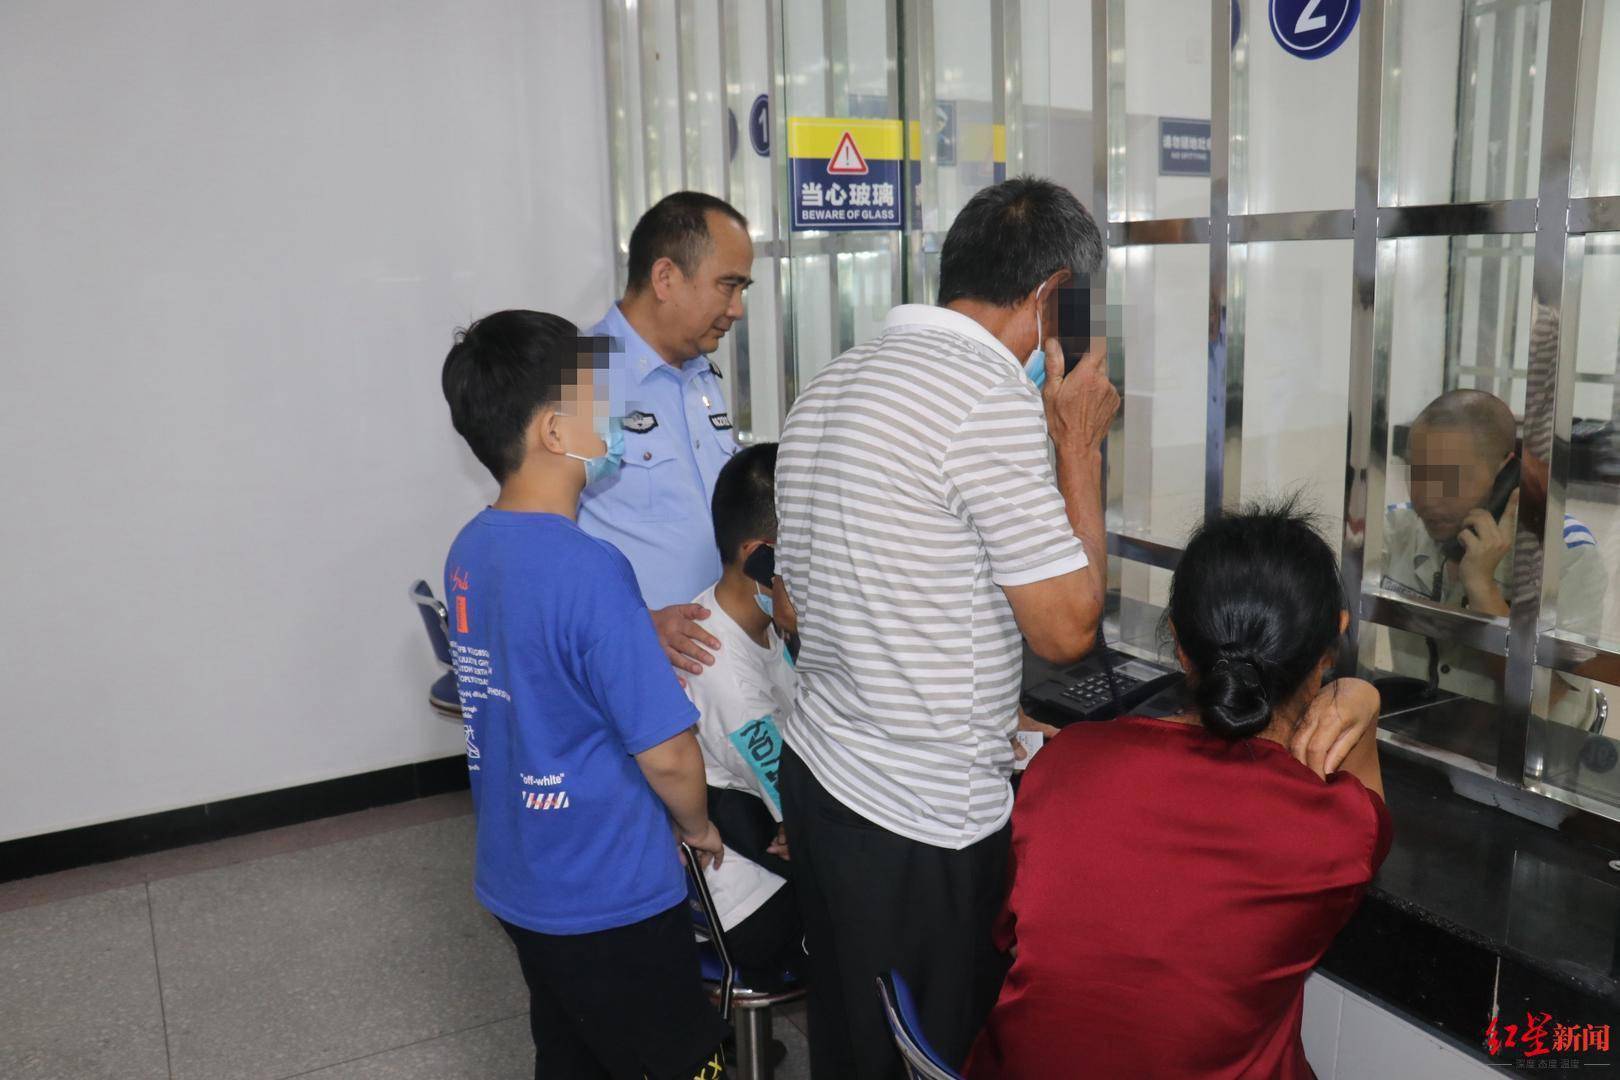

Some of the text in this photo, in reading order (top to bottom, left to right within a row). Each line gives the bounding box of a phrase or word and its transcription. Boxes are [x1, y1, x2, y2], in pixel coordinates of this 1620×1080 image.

[758, 108, 768, 144] 1
[801, 182, 895, 207] 当心玻璃
[802, 209, 895, 221] BEWARE OF GLASS
